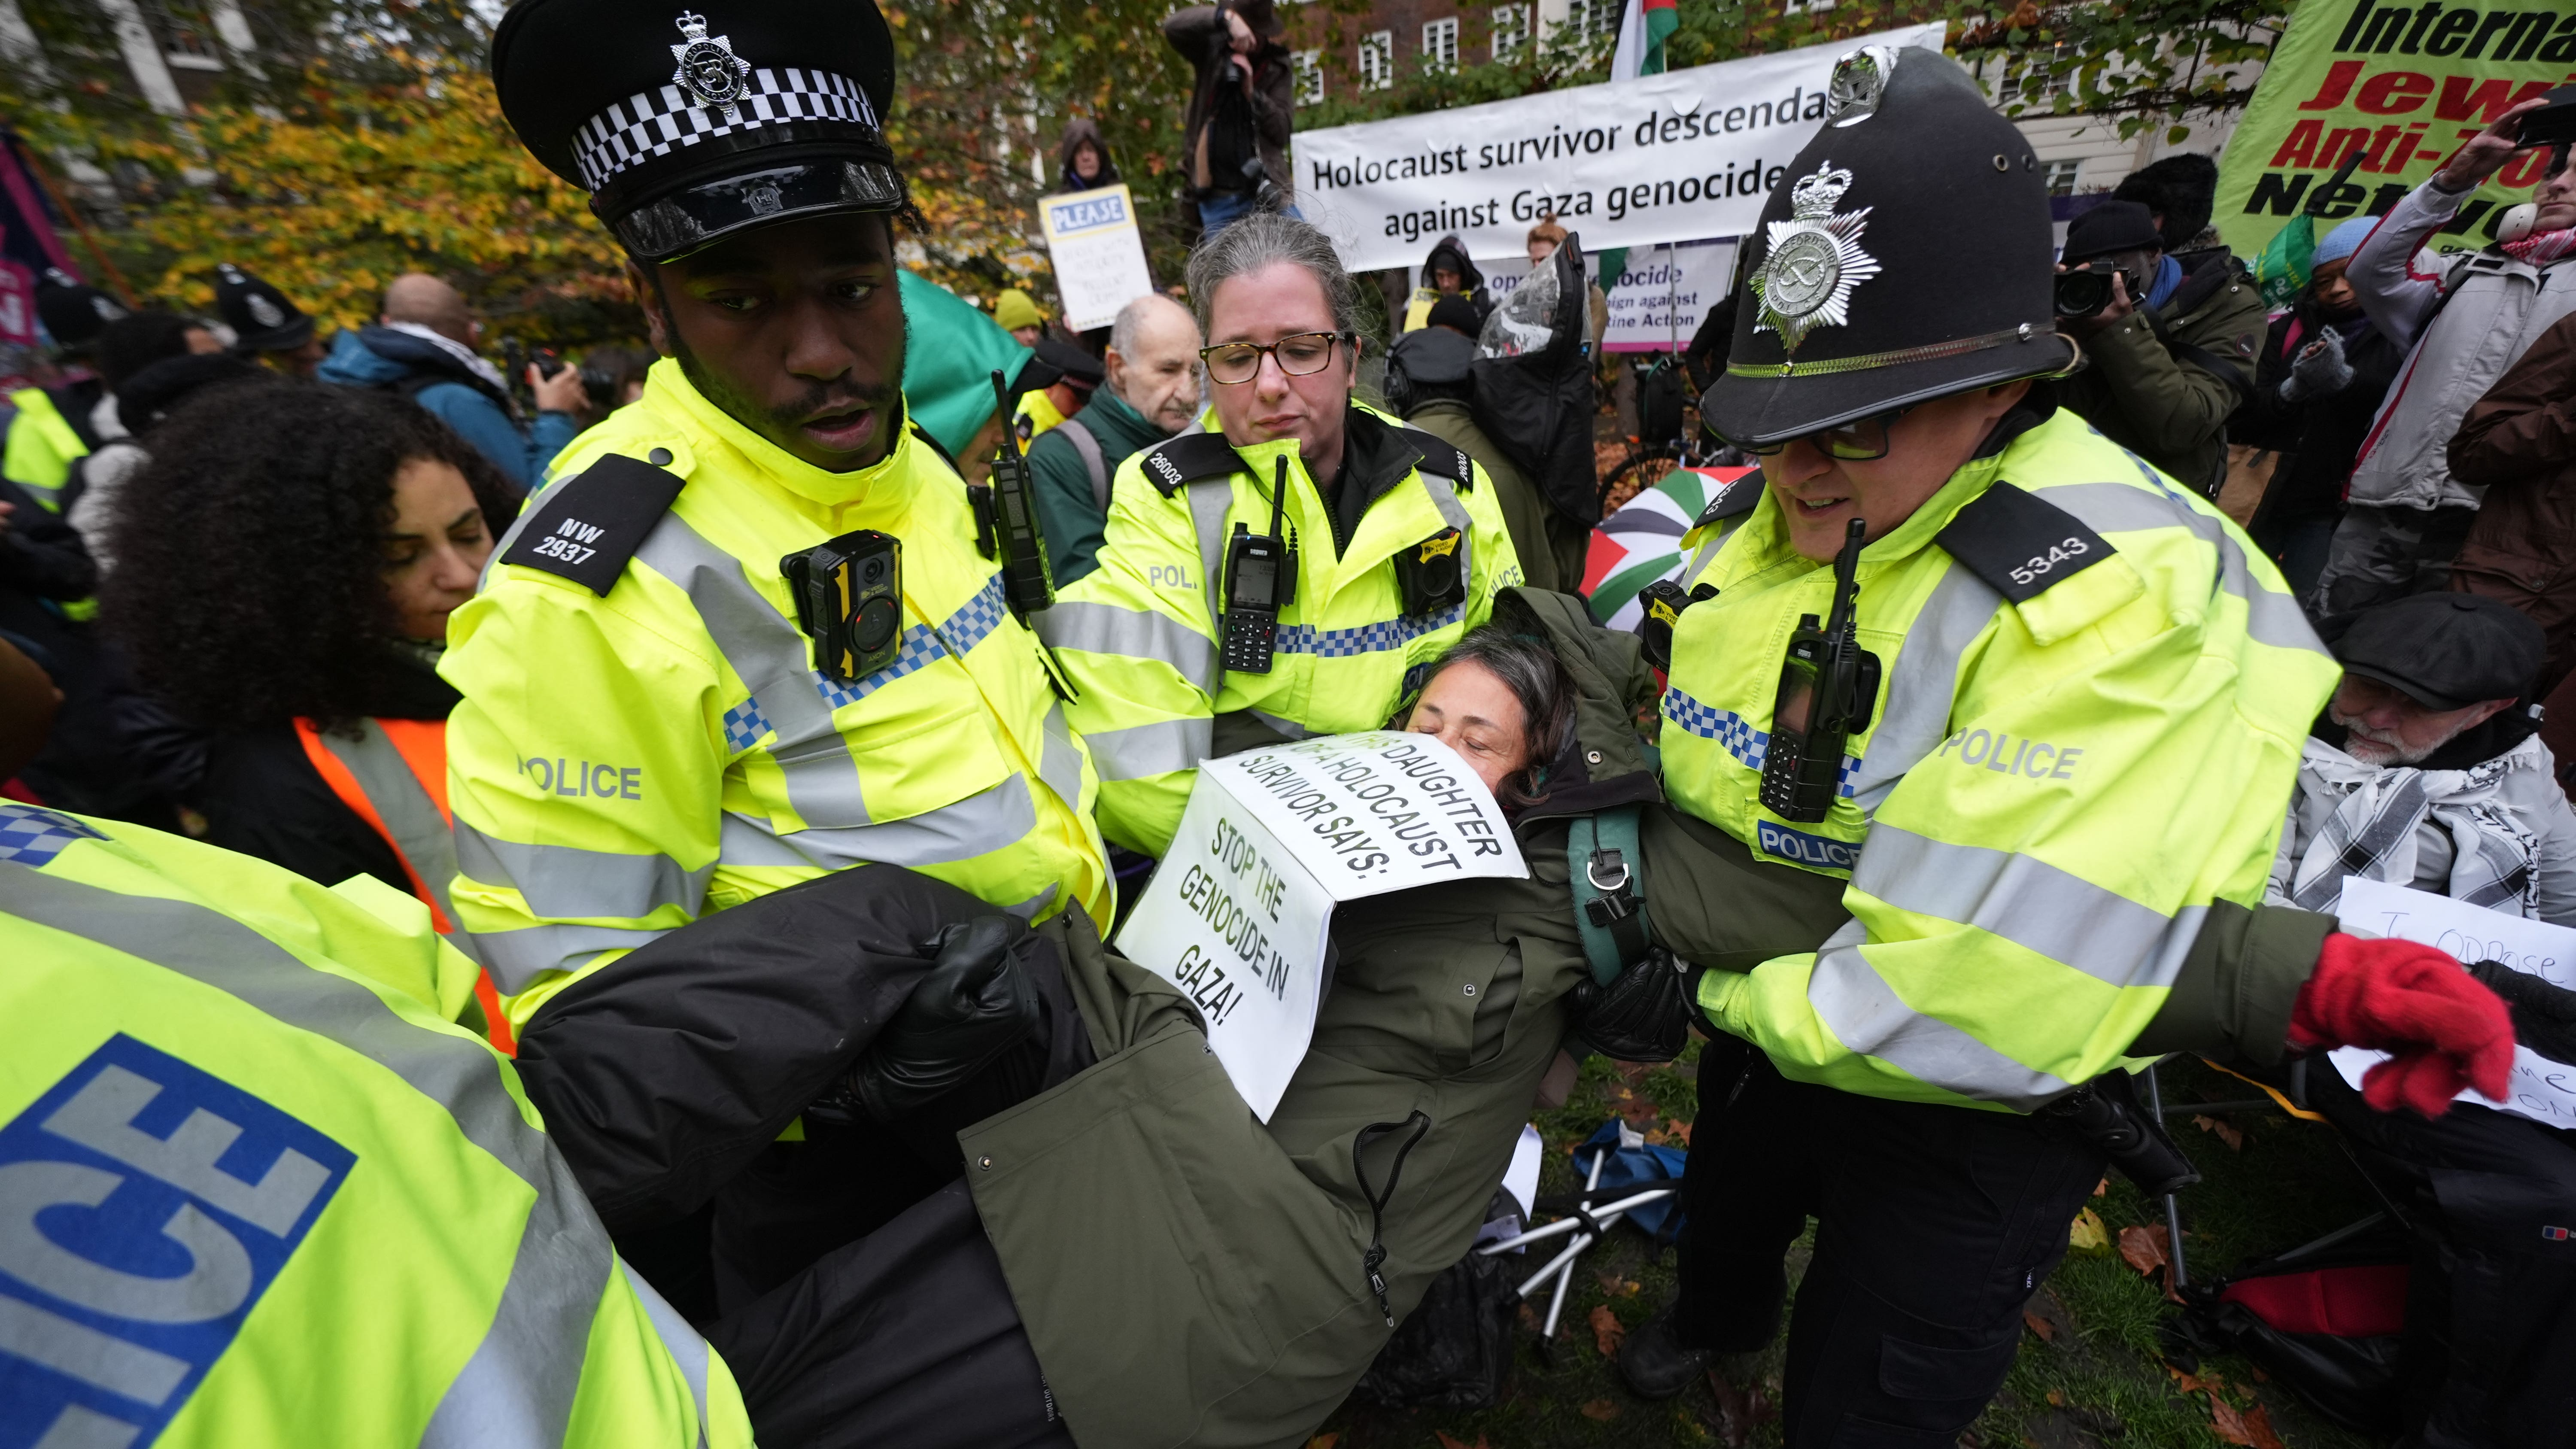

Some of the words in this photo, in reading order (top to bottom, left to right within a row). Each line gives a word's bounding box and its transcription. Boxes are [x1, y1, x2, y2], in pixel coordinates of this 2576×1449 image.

[2333, 0, 2576, 63] Interna
[705, 85, 737, 100] POLICE
[2297, 61, 2576, 125] Jew
[1312, 143, 1467, 190] Holocaust
[1479, 124, 1622, 169] survivor
[1634, 87, 1826, 146] descenda
[1052, 199, 1123, 231] PLEASE
[1385, 198, 1499, 242] against
[1512, 190, 1592, 222] Gaza
[1607, 158, 1786, 220] genocide
[1642, 313, 1694, 327] Acton
[1771, 291, 1824, 313] POLICE
[1149, 452, 1182, 484] 26003
[1456, 451, 1469, 483] 26003
[533, 536, 596, 565] 2937
[556, 518, 605, 544] NW
[1150, 565, 1197, 589] POL
[2009, 537, 2090, 584] 5343
[868, 650, 886, 662] AXON
[1938, 727, 2084, 779] POLICE
[1239, 755, 1338, 822] SURVIVOR
[1313, 816, 1390, 879] SAYS:
[1322, 757, 1462, 871] HOLOCAUST
[1380, 744, 1503, 858] DAUGHTER
[1212, 817, 1256, 880] STOP
[1255, 856, 1286, 924] THE
[1180, 864, 1269, 978] GENOCIDE
[1266, 950, 1289, 1001] IN
[1175, 945, 1243, 1026] GAZA!
